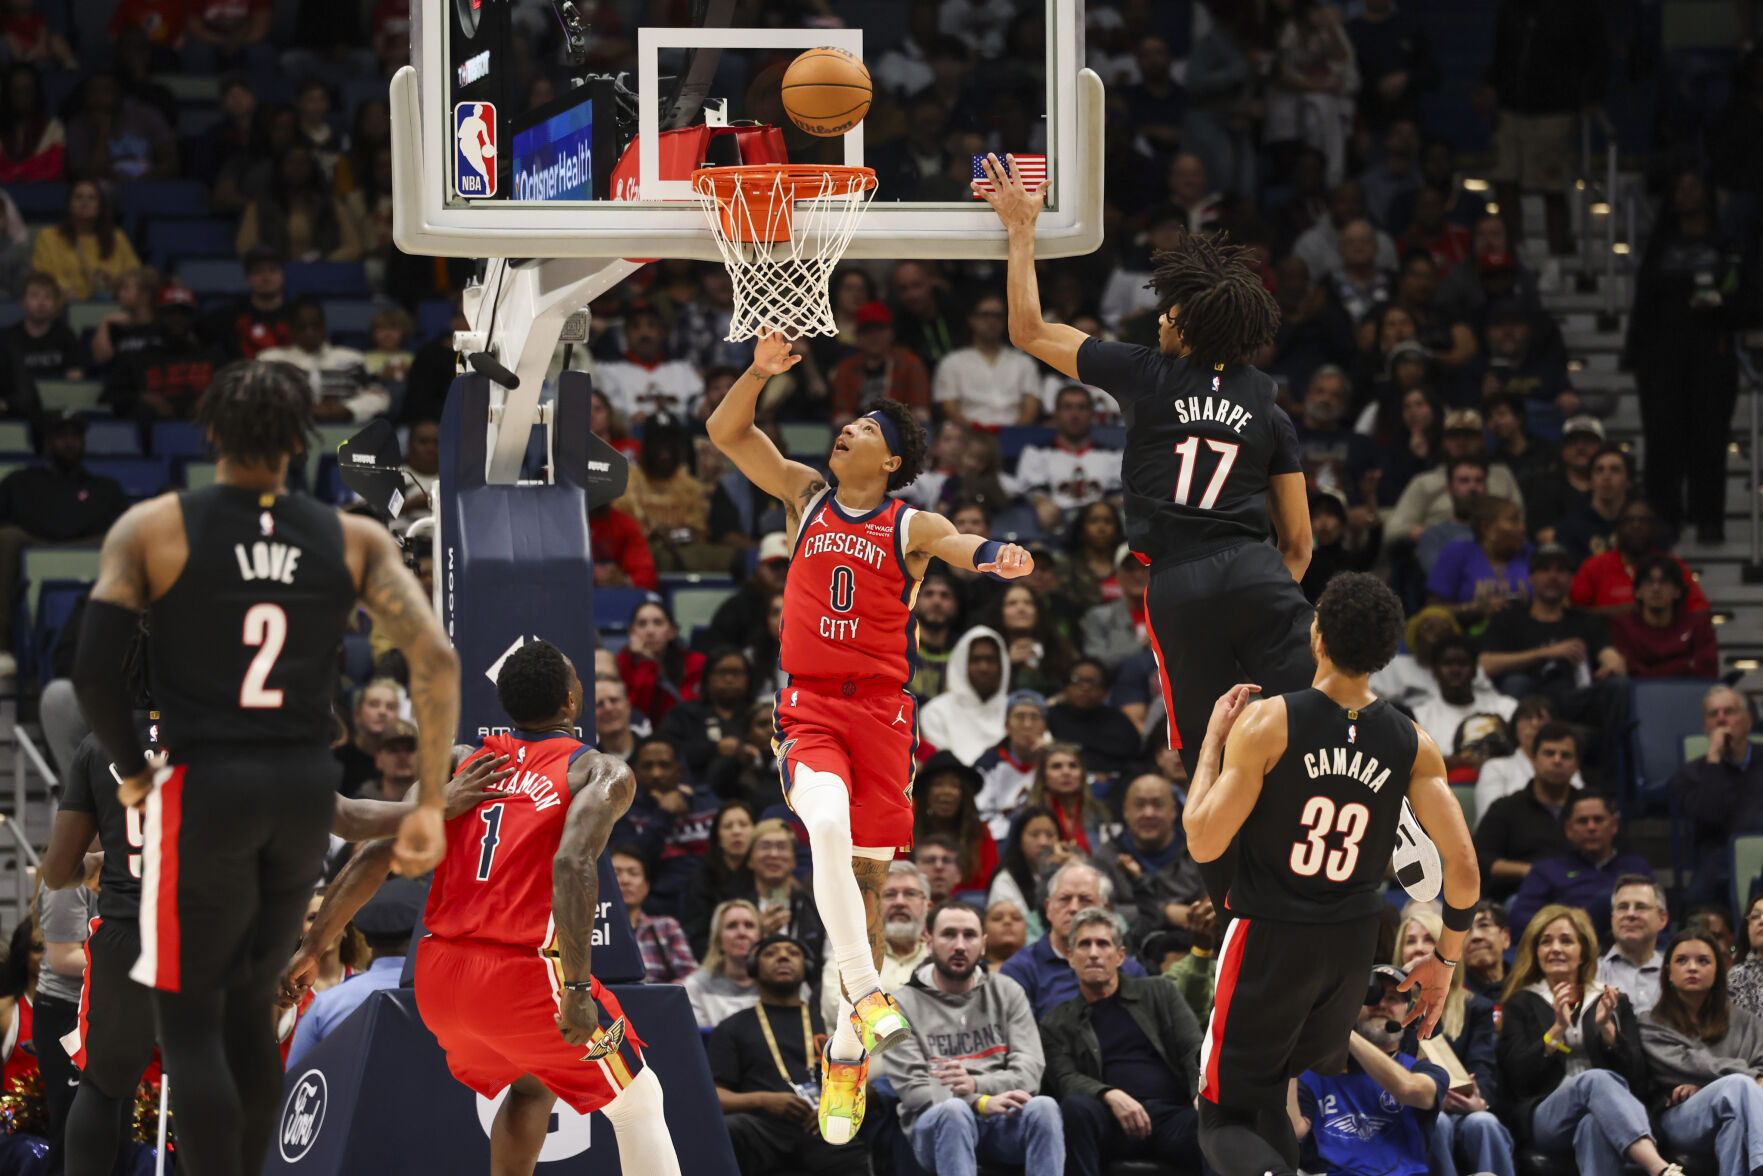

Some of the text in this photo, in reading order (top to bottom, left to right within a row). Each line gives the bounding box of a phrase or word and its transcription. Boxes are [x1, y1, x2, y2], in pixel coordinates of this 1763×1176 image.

[462, 175, 482, 191] NBA
[1174, 396, 1253, 434] SHARPE
[1174, 435, 1240, 510] 17
[804, 532, 887, 570] CRESCENT
[864, 523, 894, 533] NEWAGE
[234, 541, 302, 584] LOVE
[829, 565, 856, 613] 0
[819, 616, 860, 641] CITY
[238, 602, 289, 708] 2
[1303, 747, 1392, 793] CAMARA
[476, 802, 505, 881] 1
[1289, 795, 1370, 882] 33
[284, 1081, 320, 1146] Ford
